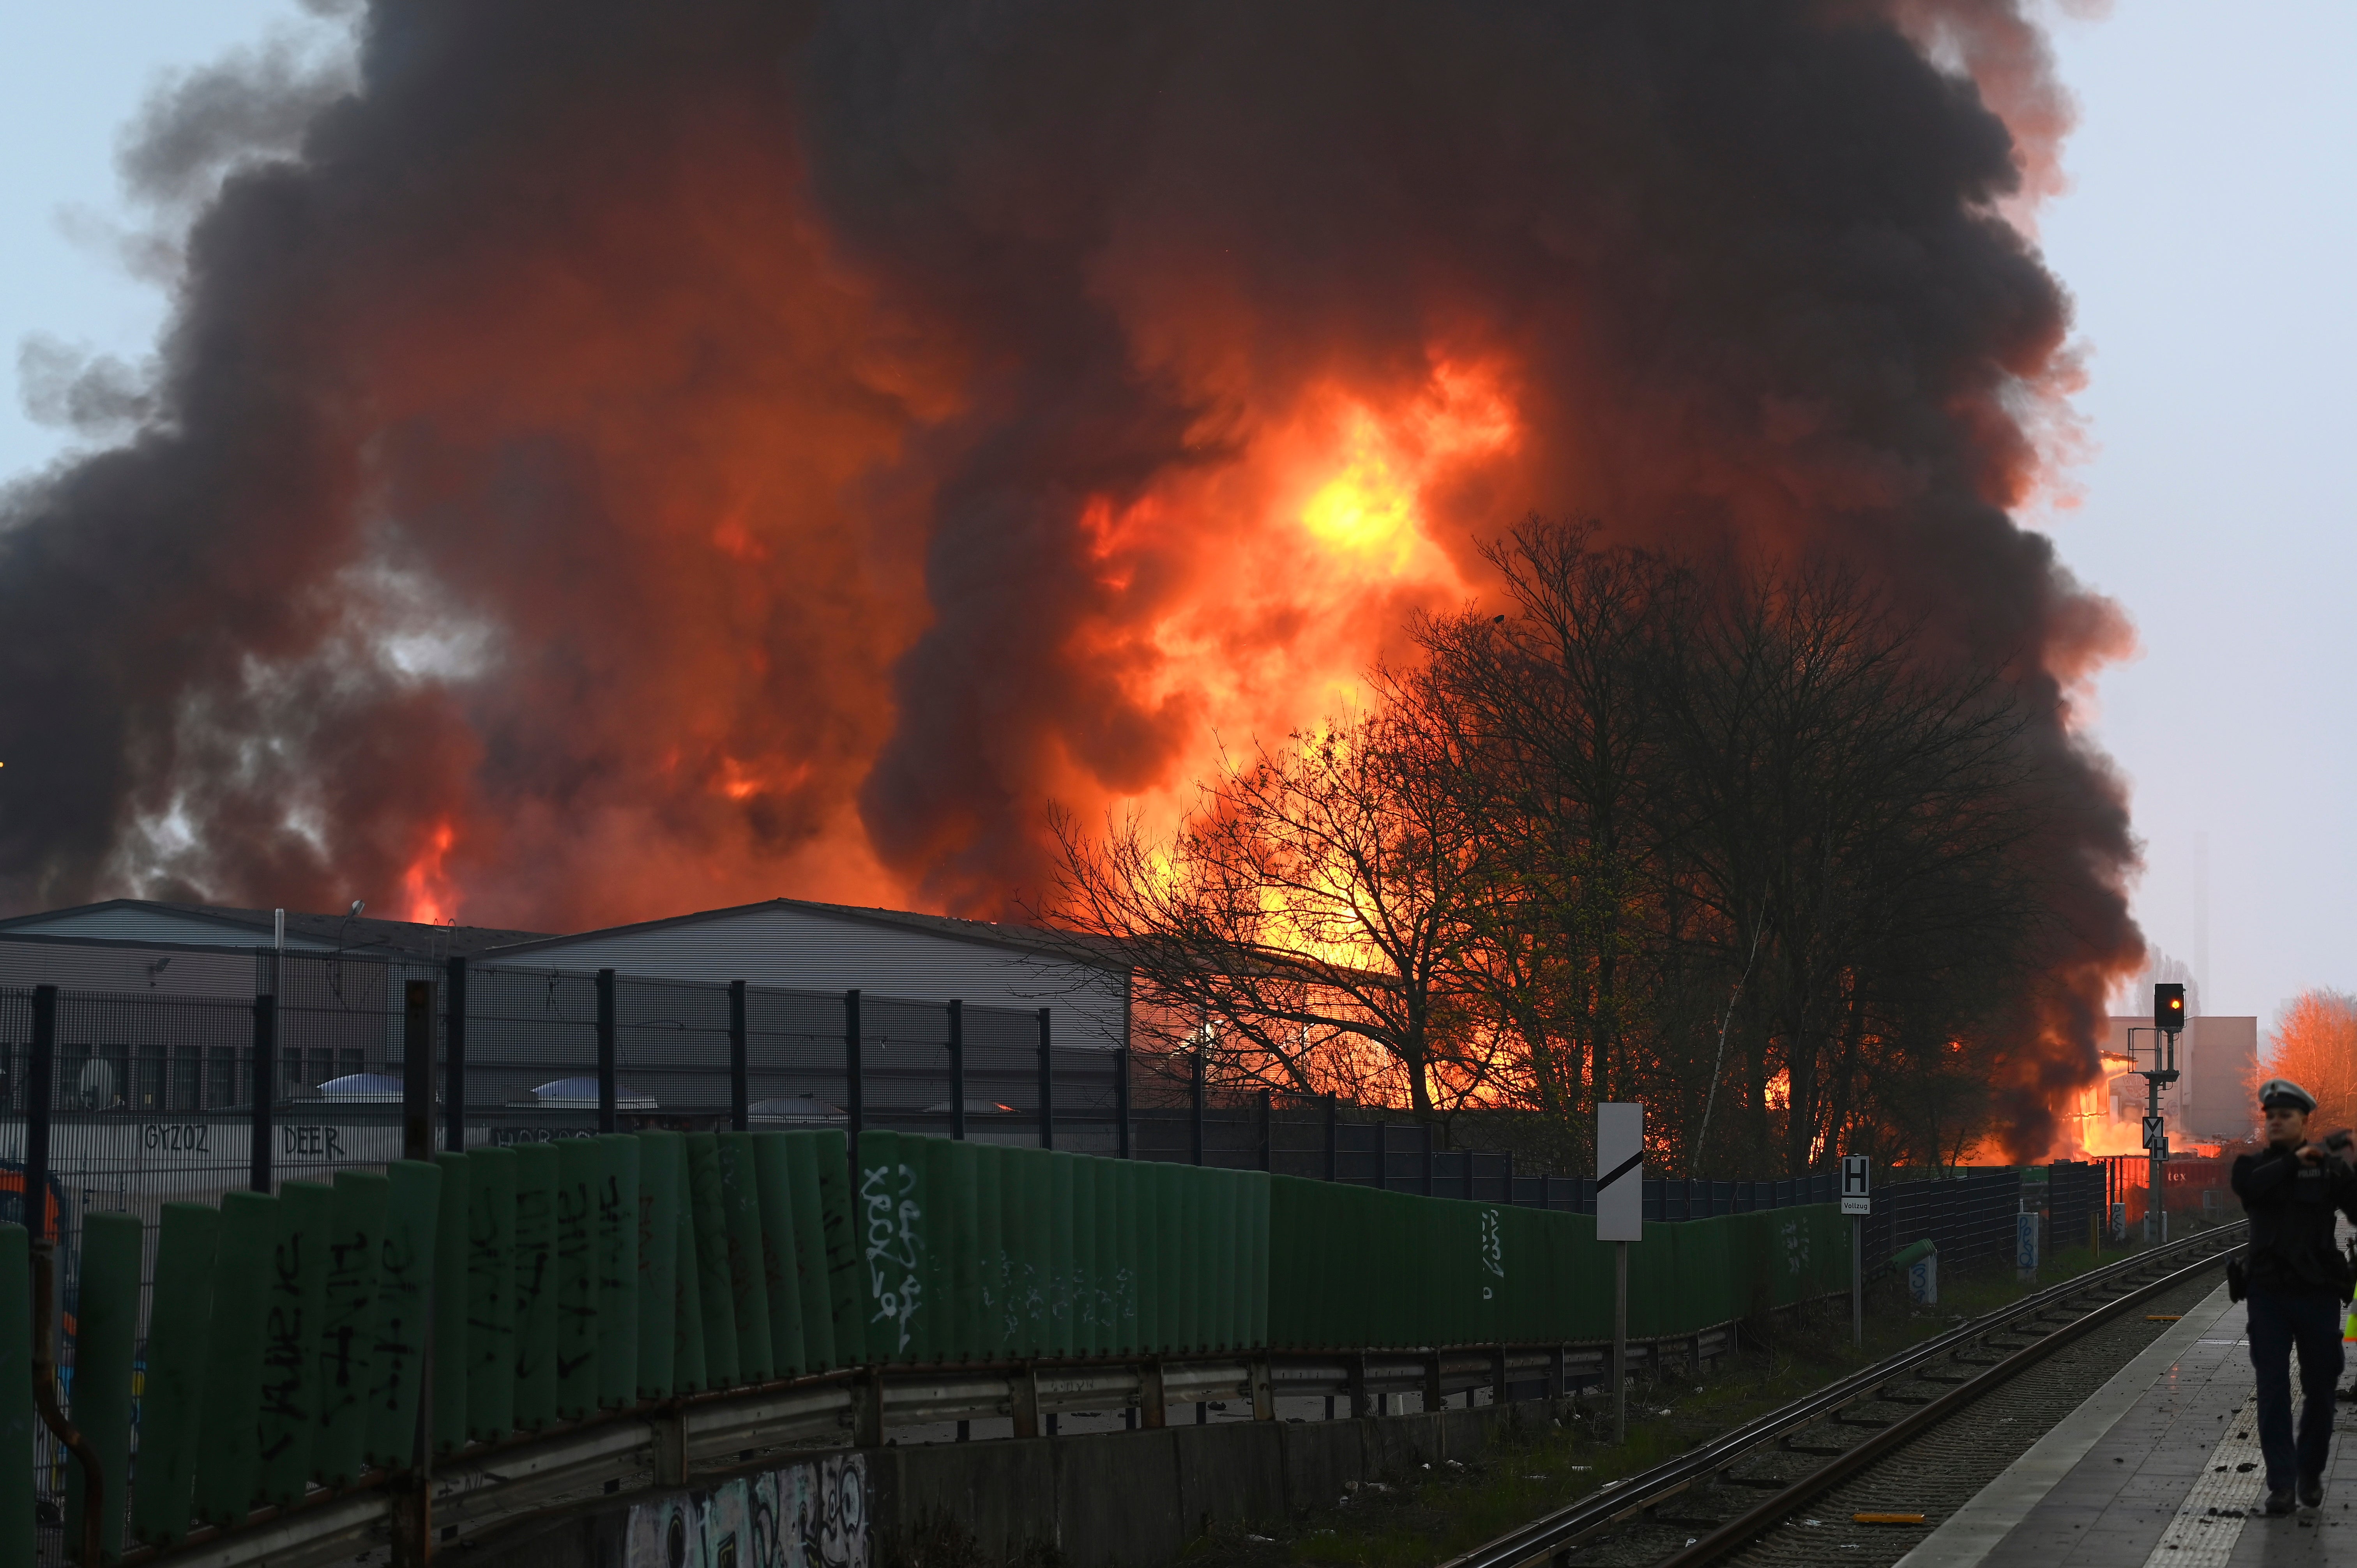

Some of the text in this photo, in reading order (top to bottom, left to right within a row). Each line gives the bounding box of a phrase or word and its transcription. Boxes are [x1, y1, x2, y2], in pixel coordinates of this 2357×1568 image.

[284, 1126, 344, 1160] DEER
[2154, 1139, 2166, 1158] H
[1845, 1159, 1866, 1192] H
